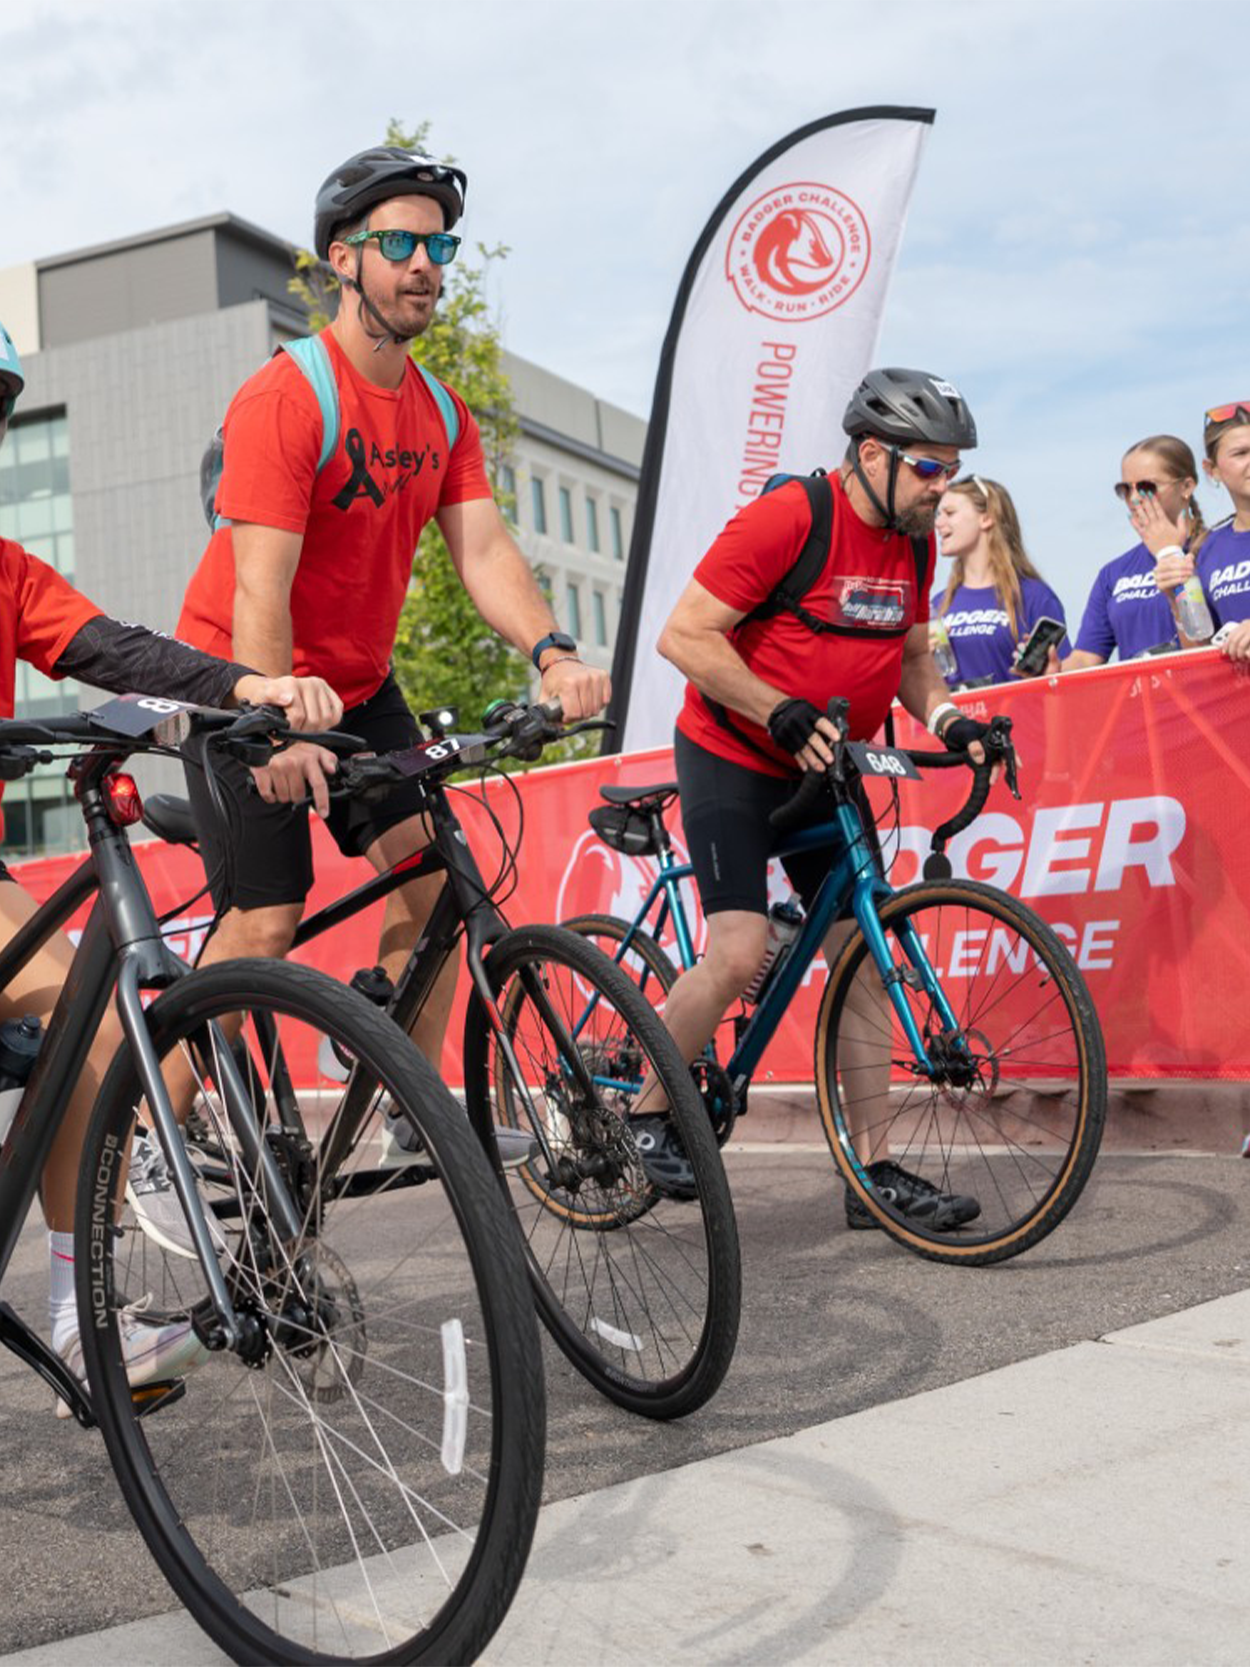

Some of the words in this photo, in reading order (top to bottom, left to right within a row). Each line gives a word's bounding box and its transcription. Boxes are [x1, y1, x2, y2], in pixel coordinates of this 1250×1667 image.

[742, 194, 793, 242] BADGER
[798, 192, 861, 252] CHALLENGE
[740, 264, 767, 301] WALK
[774, 301, 808, 312] RUN
[818, 274, 850, 304] RIDE
[737, 341, 797, 497] POWERING
[942, 609, 1010, 627] ADGER
[425, 738, 460, 760] 87
[91, 1149, 114, 1329] CONNECTION
